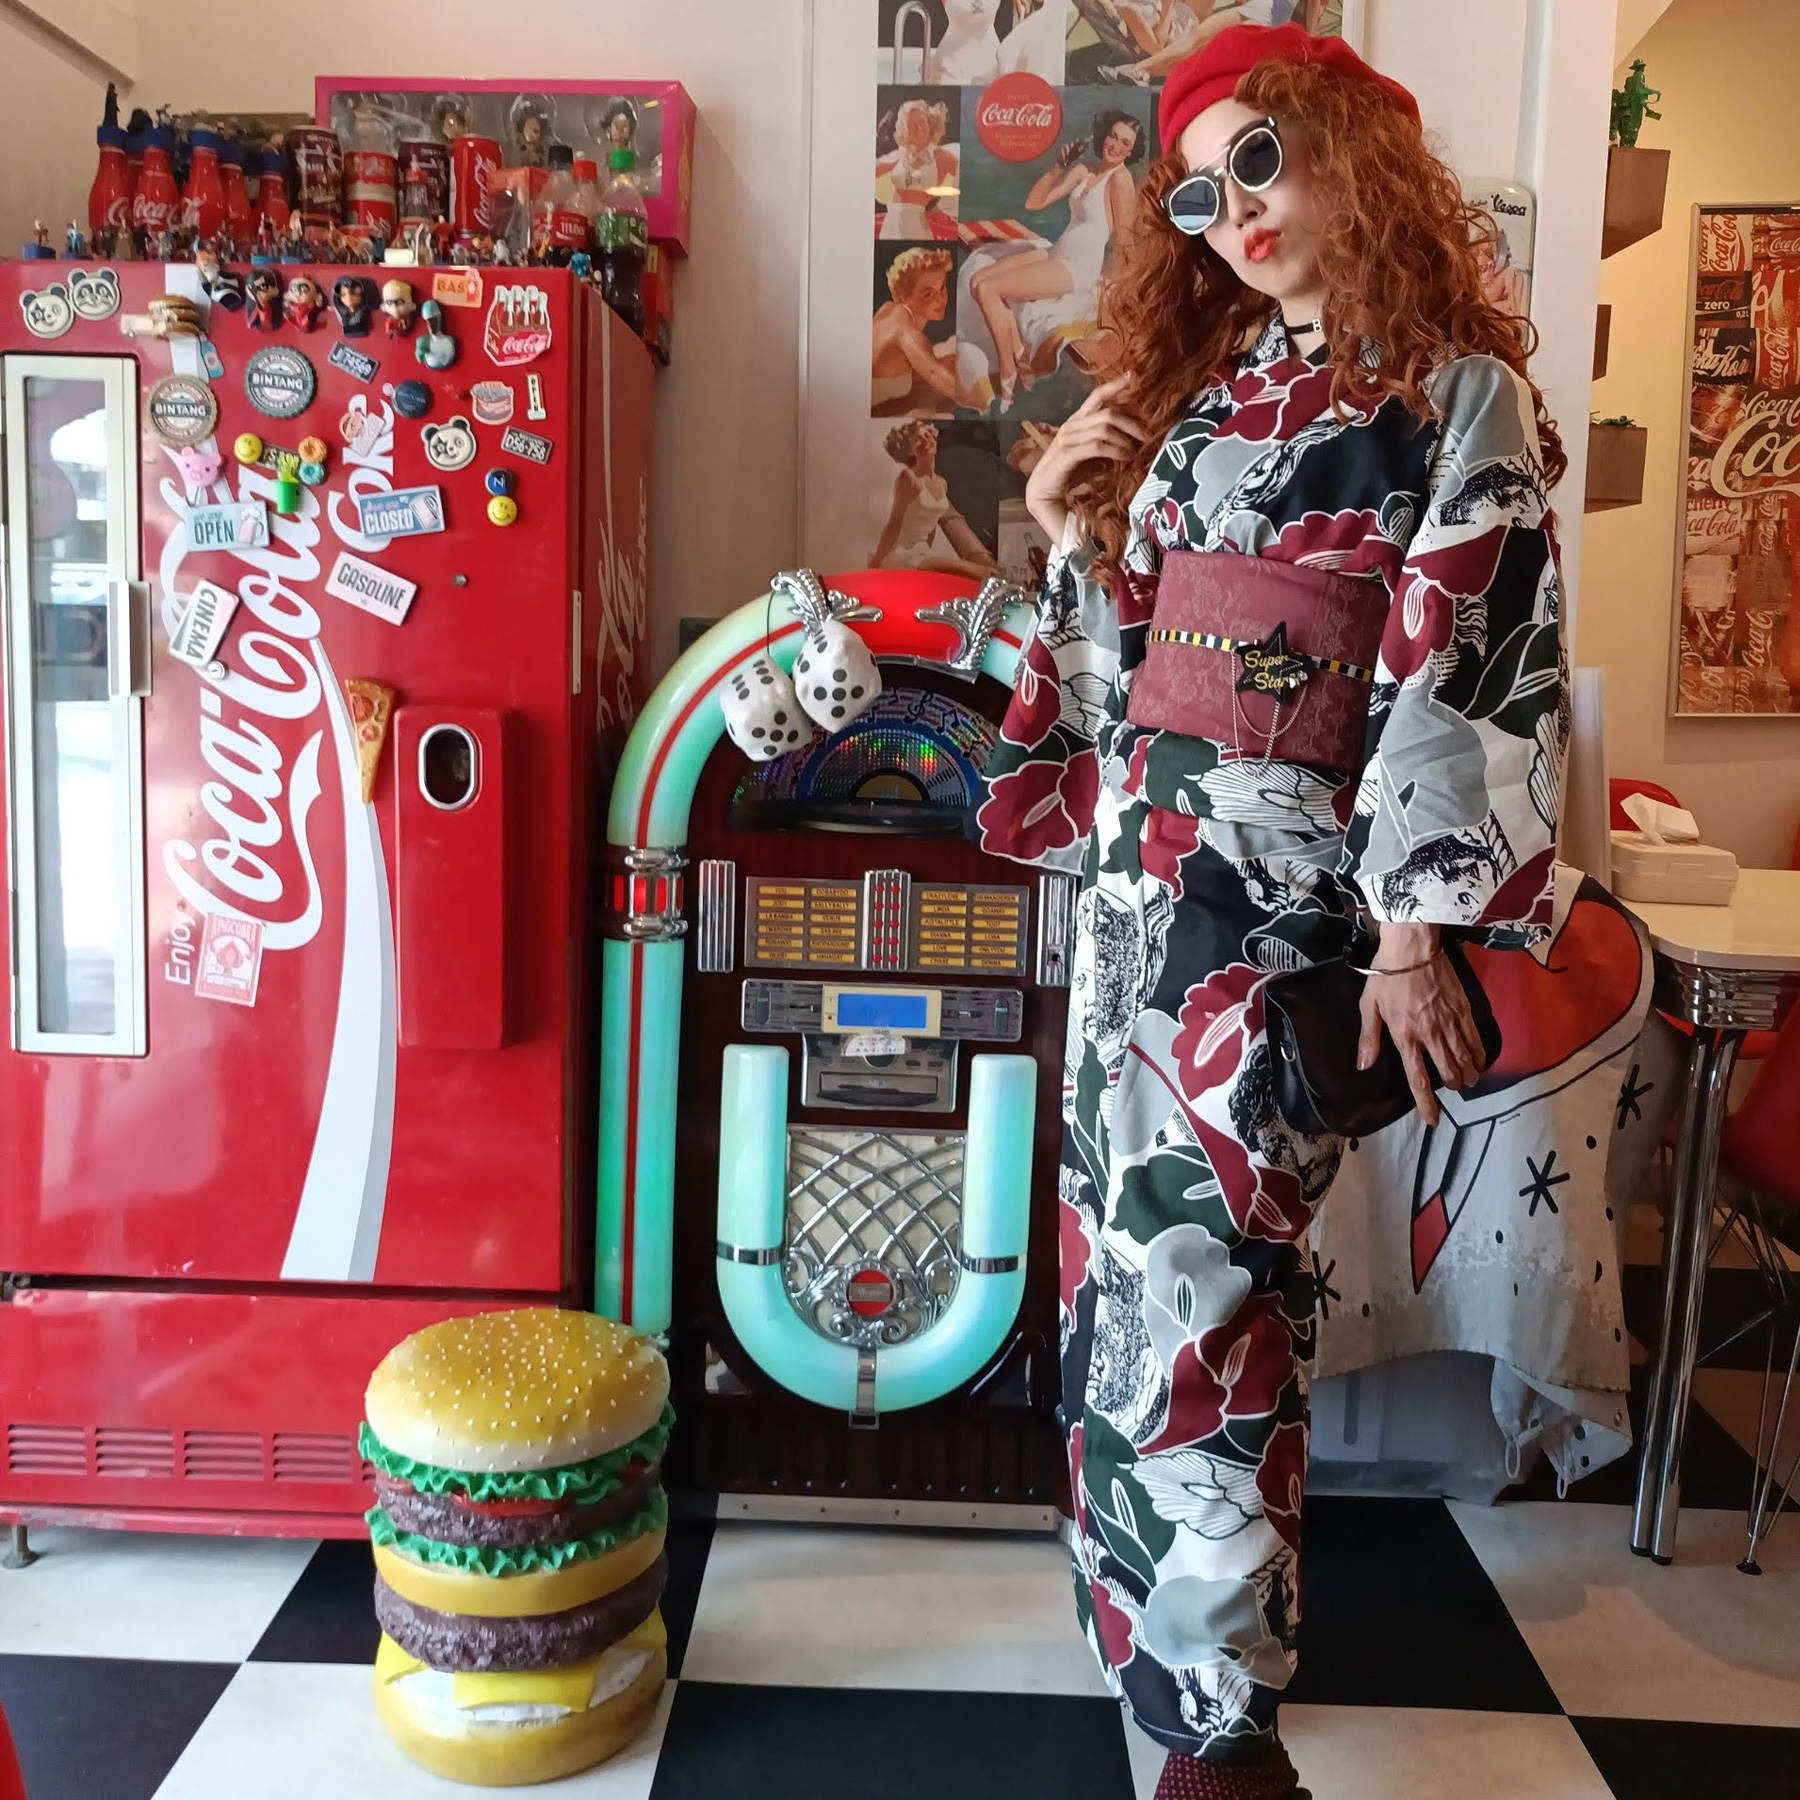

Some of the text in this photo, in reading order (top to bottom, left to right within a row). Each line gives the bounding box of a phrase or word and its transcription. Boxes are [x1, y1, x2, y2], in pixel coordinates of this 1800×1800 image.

[982, 103, 1055, 127] Coca-Cola
[1491, 193, 1528, 216] Vespa
[437, 281, 465, 294] GAS
[1704, 301, 1730, 310] zero
[252, 373, 304, 391] BINTANG
[155, 403, 206, 417] BINTANG
[194, 519, 235, 545] OPEN
[365, 510, 415, 533] CLOSED
[337, 562, 407, 611] GASOLINE
[186, 588, 217, 660] CINEMA
[1245, 650, 1289, 672] Super
[1254, 672, 1290, 690] Star
[165, 909, 196, 986] Enjoy
